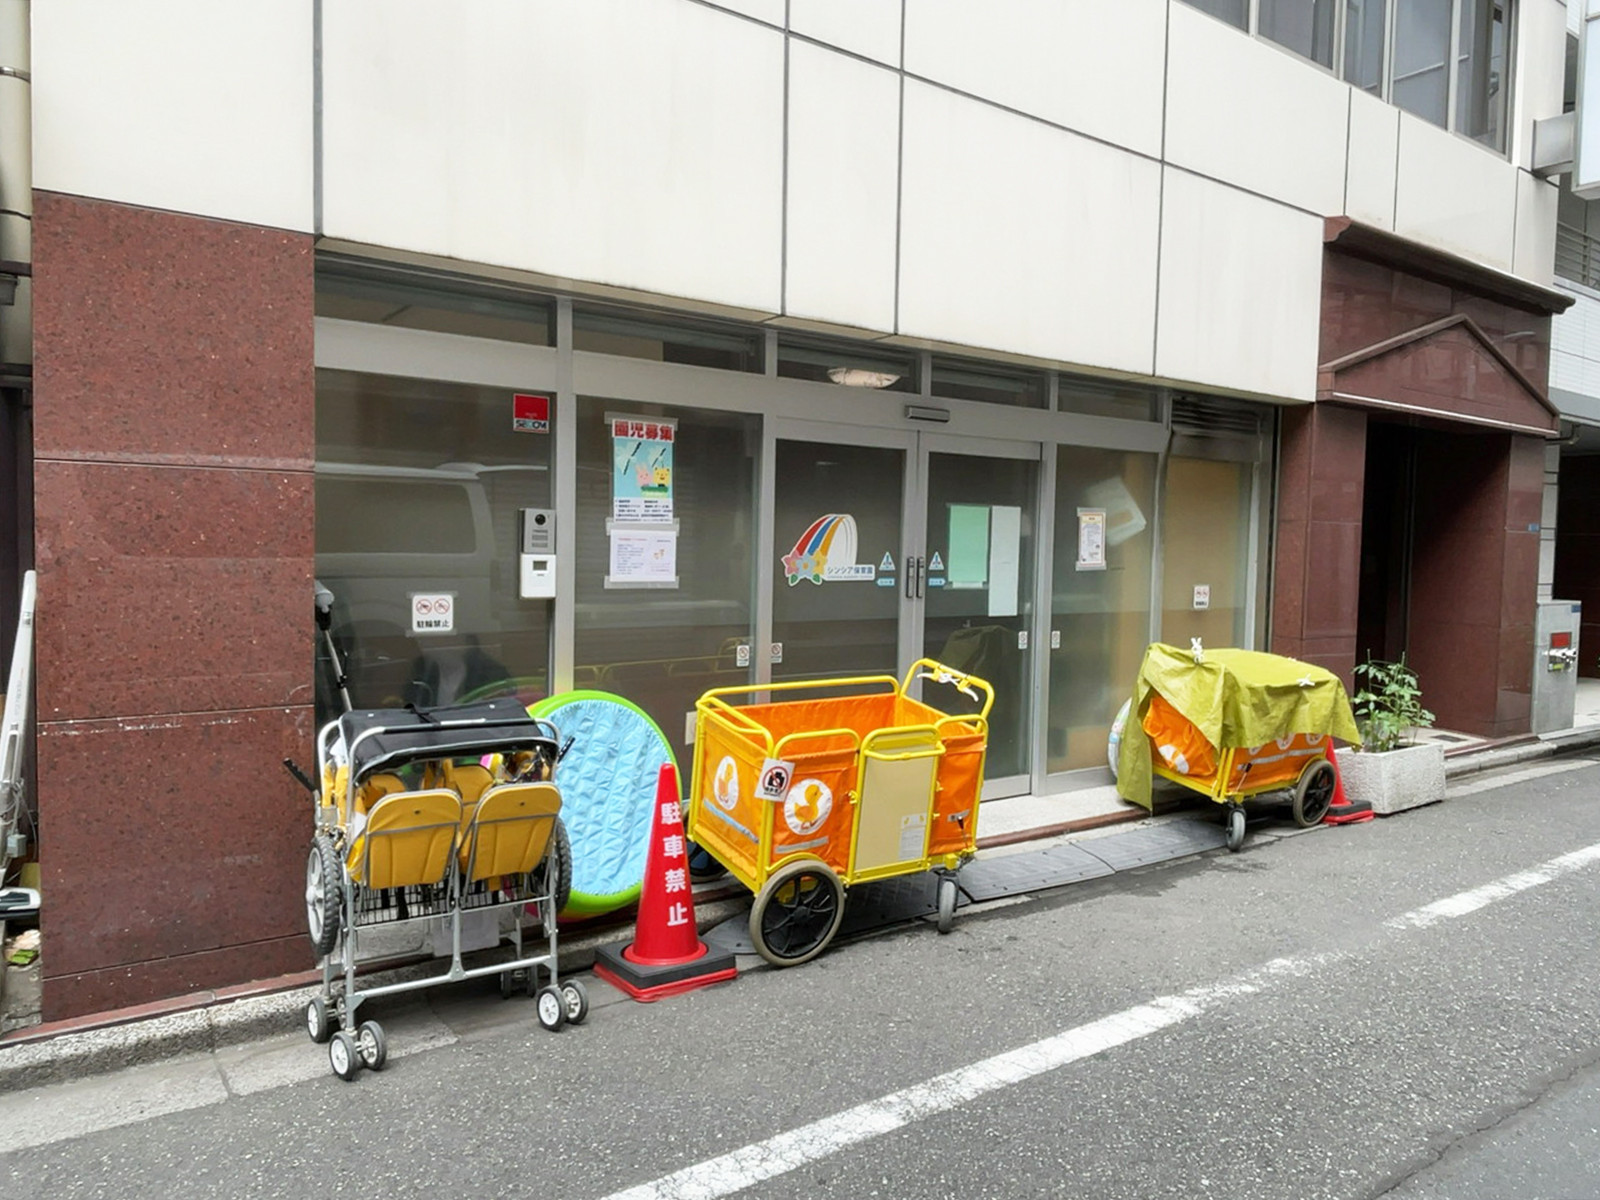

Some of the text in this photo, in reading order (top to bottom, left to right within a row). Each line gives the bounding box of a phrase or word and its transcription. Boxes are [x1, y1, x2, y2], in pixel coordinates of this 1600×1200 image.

[614, 421, 673, 441] 園児募集
[827, 566, 873, 574] シンシア保育園
[416, 620, 450, 628] 駐輪禁止
[661, 801, 688, 927] 駐車禁止
